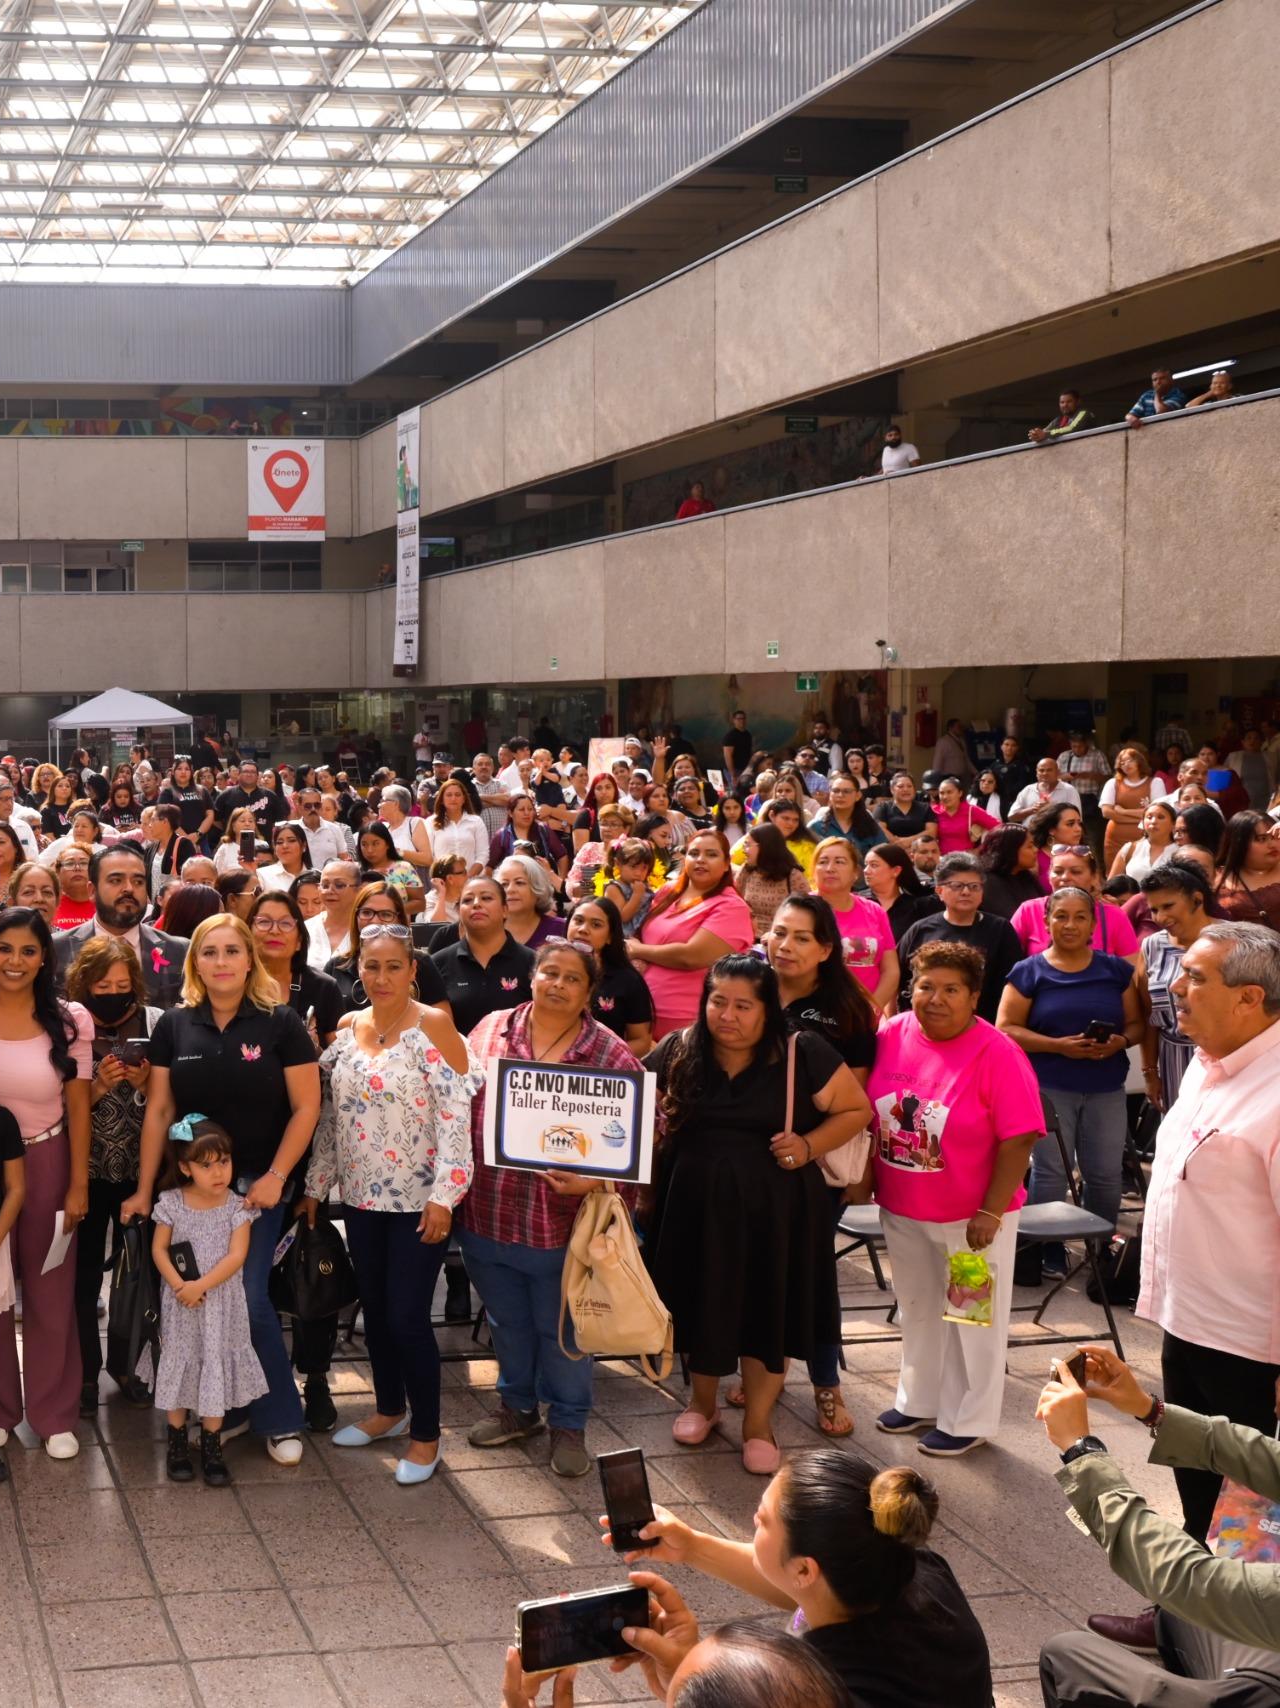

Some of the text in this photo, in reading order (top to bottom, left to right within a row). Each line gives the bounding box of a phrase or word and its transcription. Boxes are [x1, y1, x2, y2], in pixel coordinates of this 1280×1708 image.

[509, 1070, 626, 1099] C.C NVO MILENIO
[510, 1091, 622, 1117] Taller Reposteria
[1257, 1518, 1280, 1536] SE
